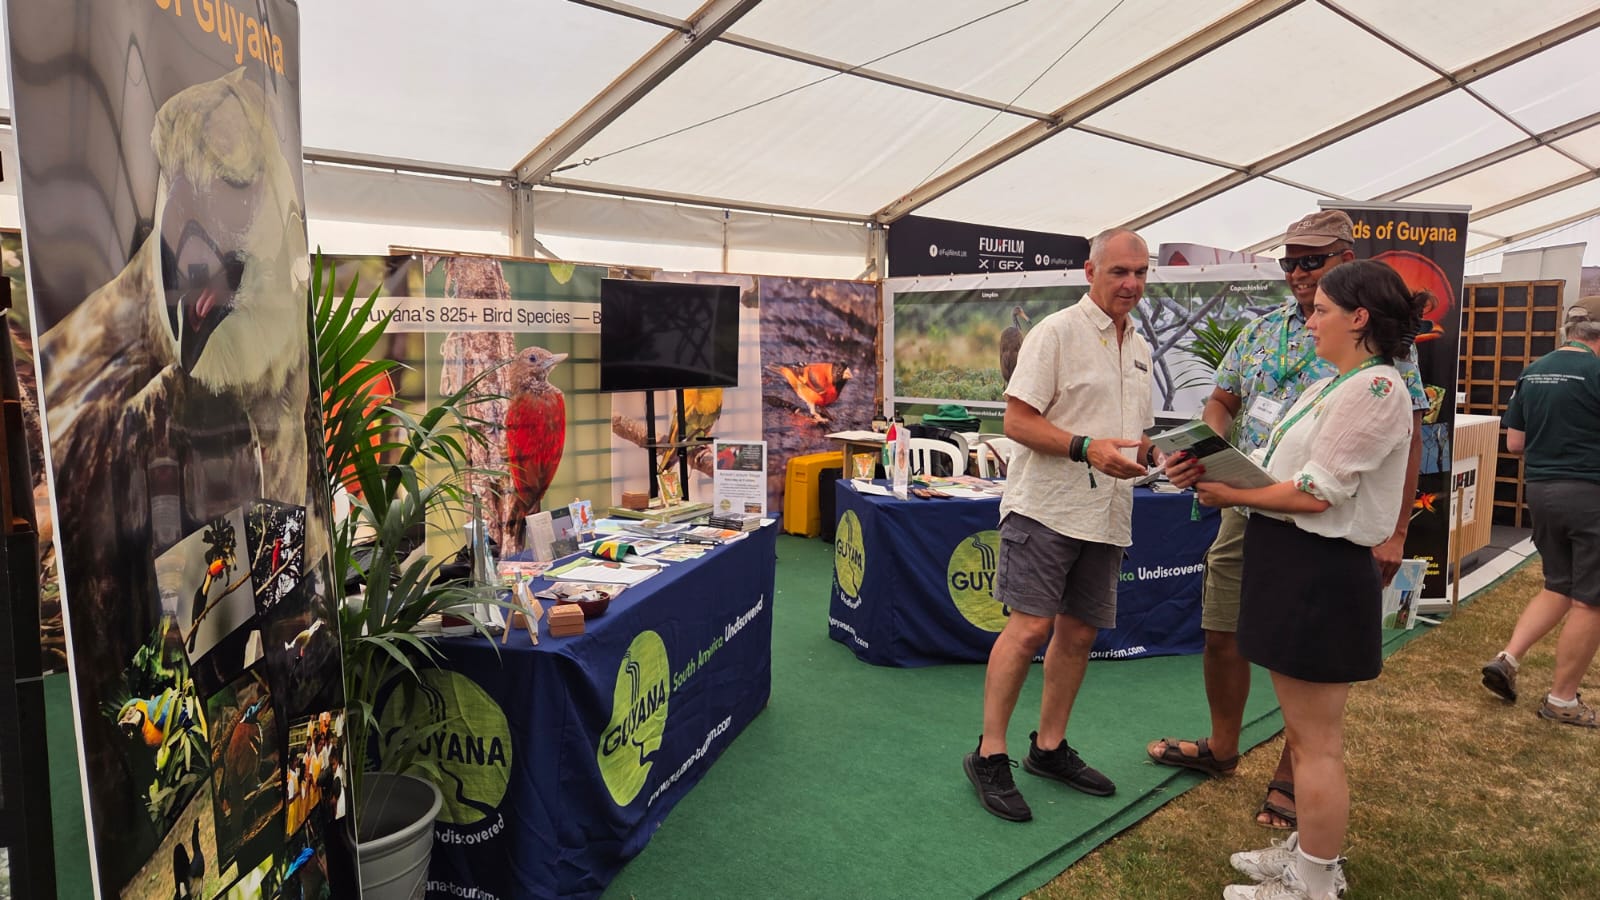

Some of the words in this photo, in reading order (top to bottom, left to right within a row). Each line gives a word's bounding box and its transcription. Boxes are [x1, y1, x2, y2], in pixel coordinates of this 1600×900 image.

[193, 0, 285, 76] Guyana
[1352, 220, 1371, 239] ds
[1375, 221, 1394, 240] of
[1397, 221, 1457, 246] Guyana
[979, 236, 1025, 254] FUJIFILM
[978, 259, 989, 269] X
[999, 261, 1024, 270] GFX
[351, 306, 436, 323] uyana's
[440, 306, 478, 323] 825+
[483, 307, 513, 323] Bird
[517, 308, 570, 326] Species
[952, 571, 996, 591] GUY
[1119, 571, 1135, 582] ica
[673, 656, 696, 692] South
[602, 678, 666, 757] GUYANA
